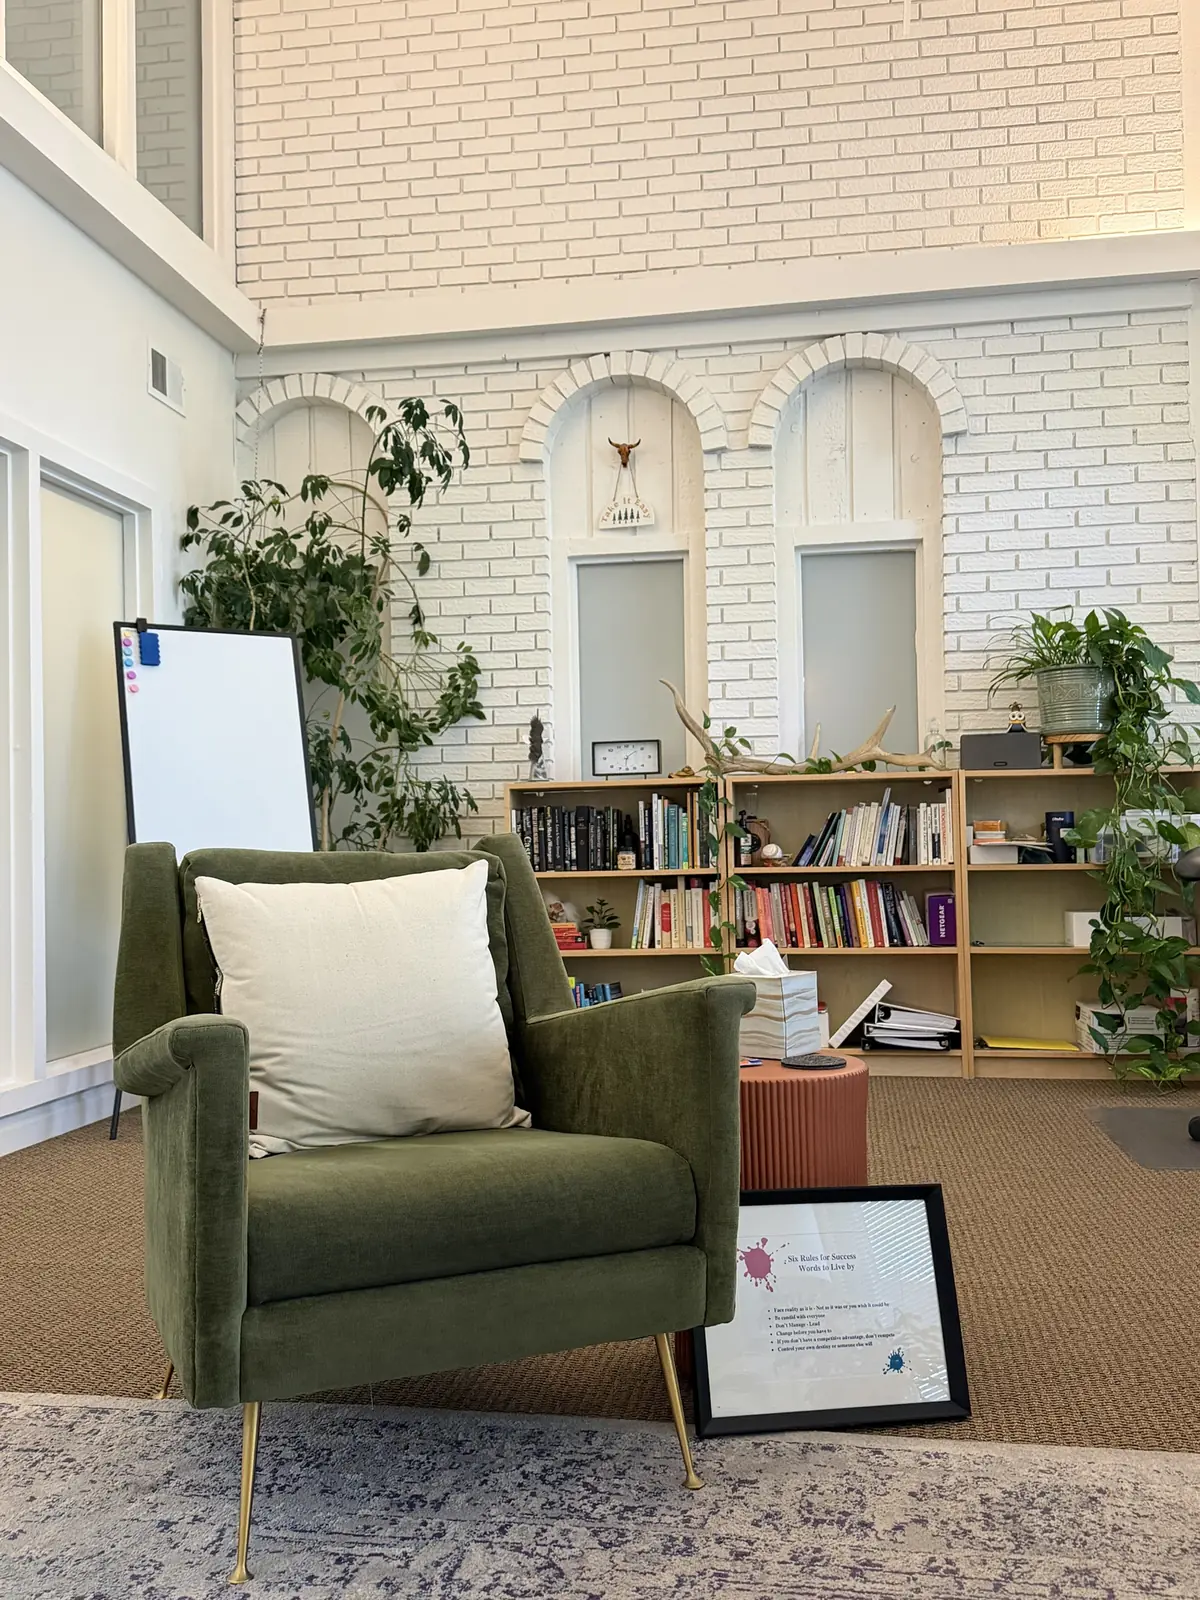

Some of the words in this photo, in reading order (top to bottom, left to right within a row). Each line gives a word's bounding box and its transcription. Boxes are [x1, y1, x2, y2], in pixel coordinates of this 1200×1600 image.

[601, 502, 619, 522] Take
[635, 499, 650, 518] Easy
[938, 904, 946, 938] NETGEAR
[800, 1254, 819, 1262] Rules
[820, 1253, 830, 1261] for
[831, 1252, 857, 1261] Success
[798, 1264, 821, 1272] Words
[830, 1263, 846, 1271] Live
[846, 1262, 855, 1272] by
